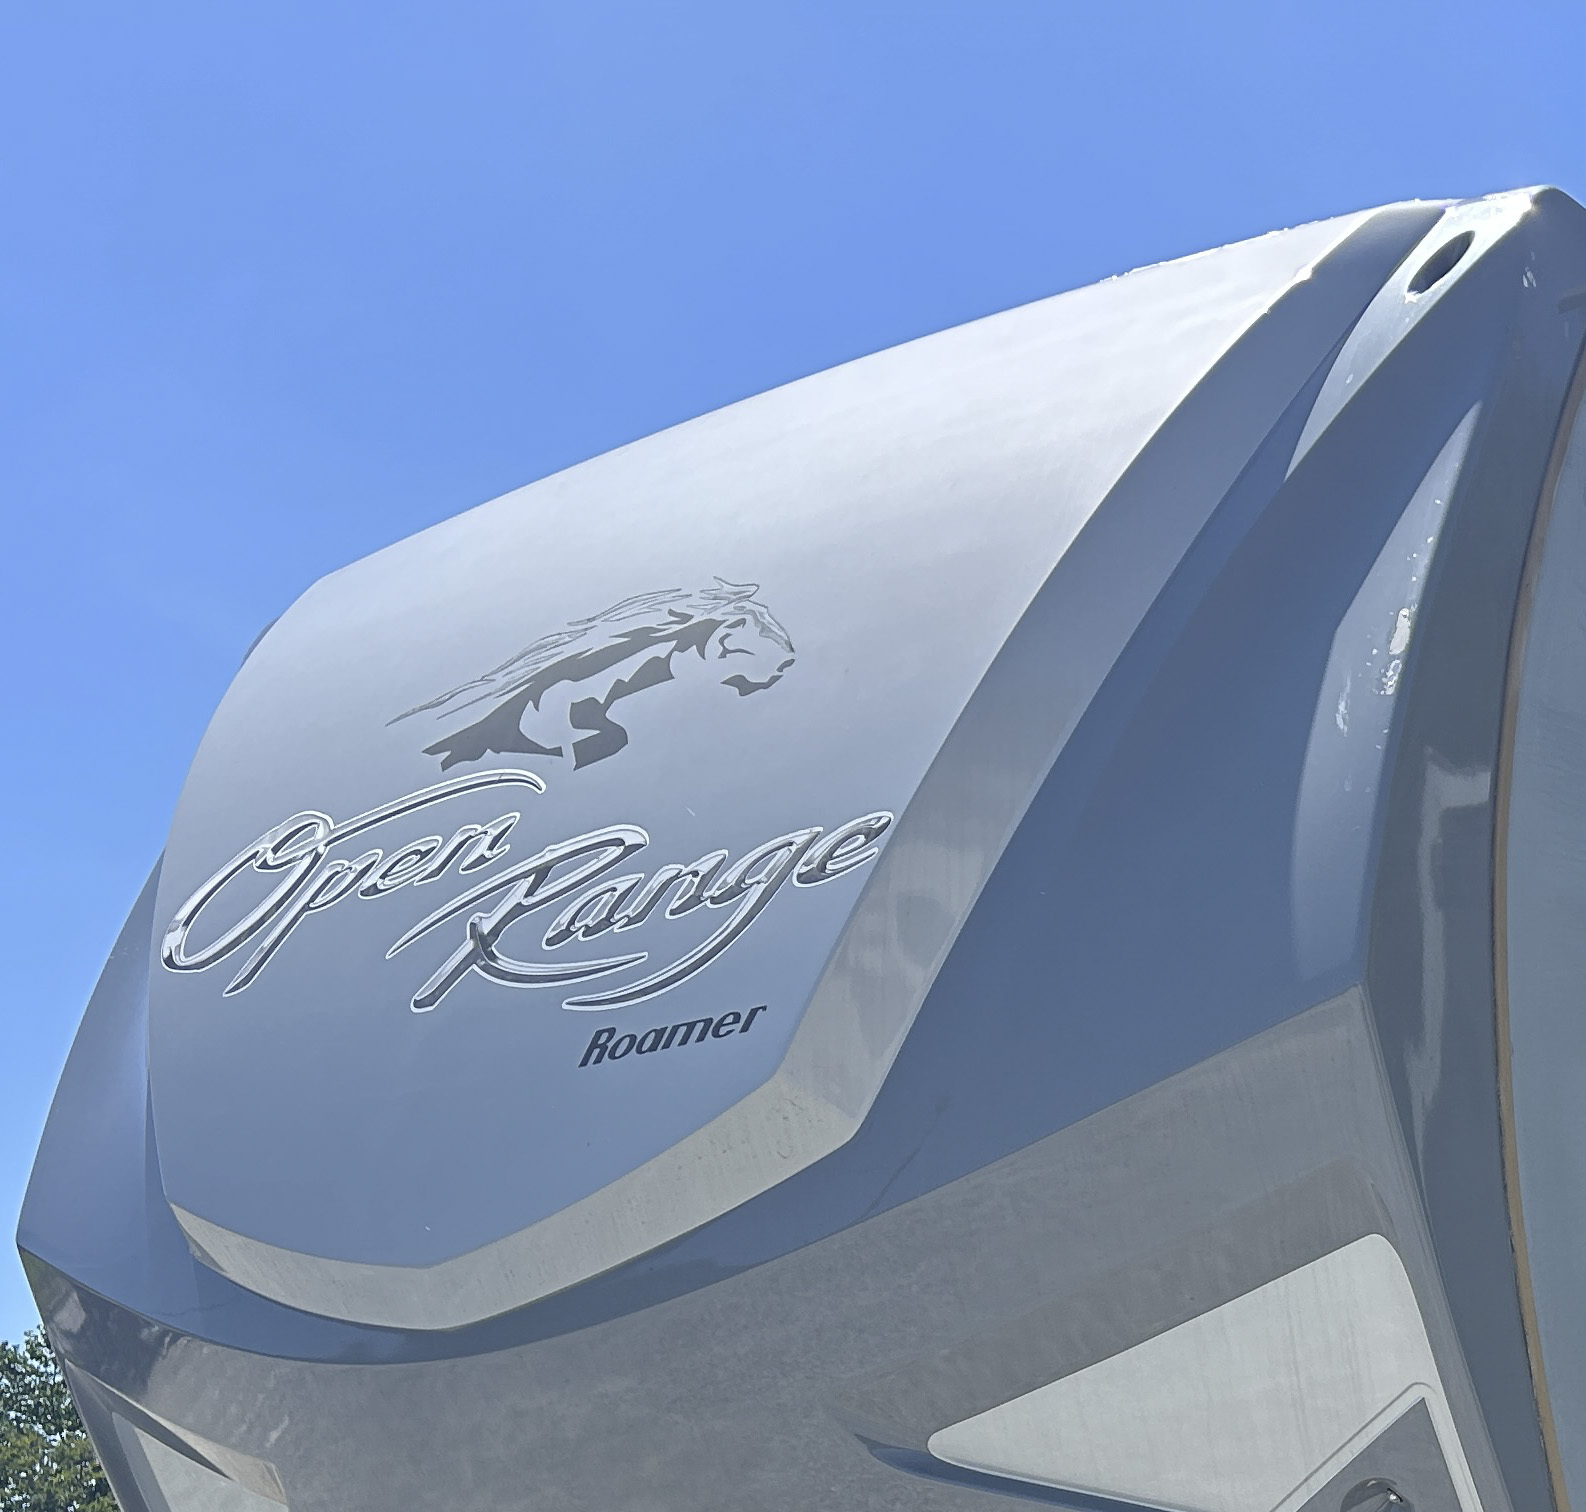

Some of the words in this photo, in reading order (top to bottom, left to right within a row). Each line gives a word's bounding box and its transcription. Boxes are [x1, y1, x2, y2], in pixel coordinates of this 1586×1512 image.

[161, 769, 546, 996] Open
[386, 811, 894, 1012] Range
[578, 1005, 767, 1068] Roamer
